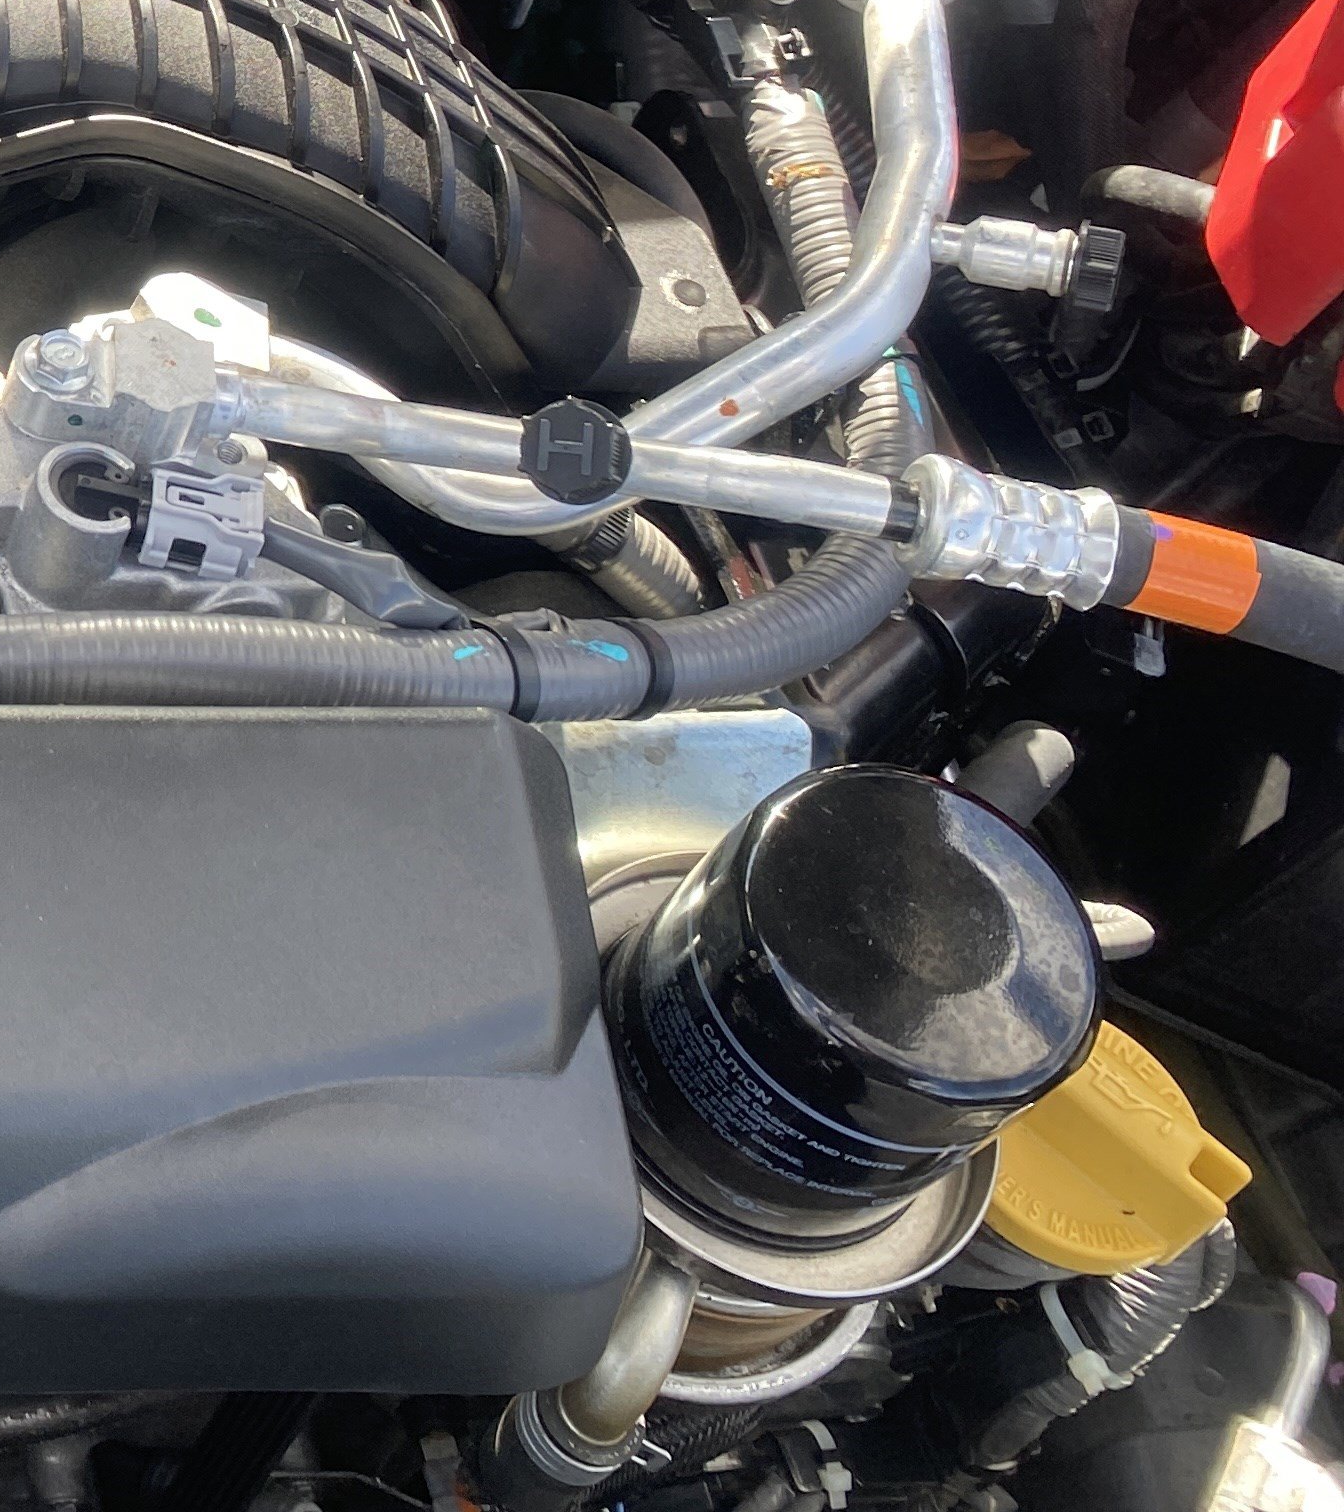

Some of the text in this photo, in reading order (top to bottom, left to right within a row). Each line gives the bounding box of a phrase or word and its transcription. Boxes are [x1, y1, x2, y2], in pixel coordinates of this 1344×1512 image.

[537, 418, 594, 476] H
[703, 1023, 772, 1105] CAUTION
[710, 1121, 740, 1146] FOR
[736, 1144, 806, 1183] REPLACE
[749, 1101, 809, 1141] GASKET
[805, 1139, 843, 1157] AND
[838, 1153, 908, 1170] TIGHTEN
[1049, 1212, 1143, 1249] MANUAL
